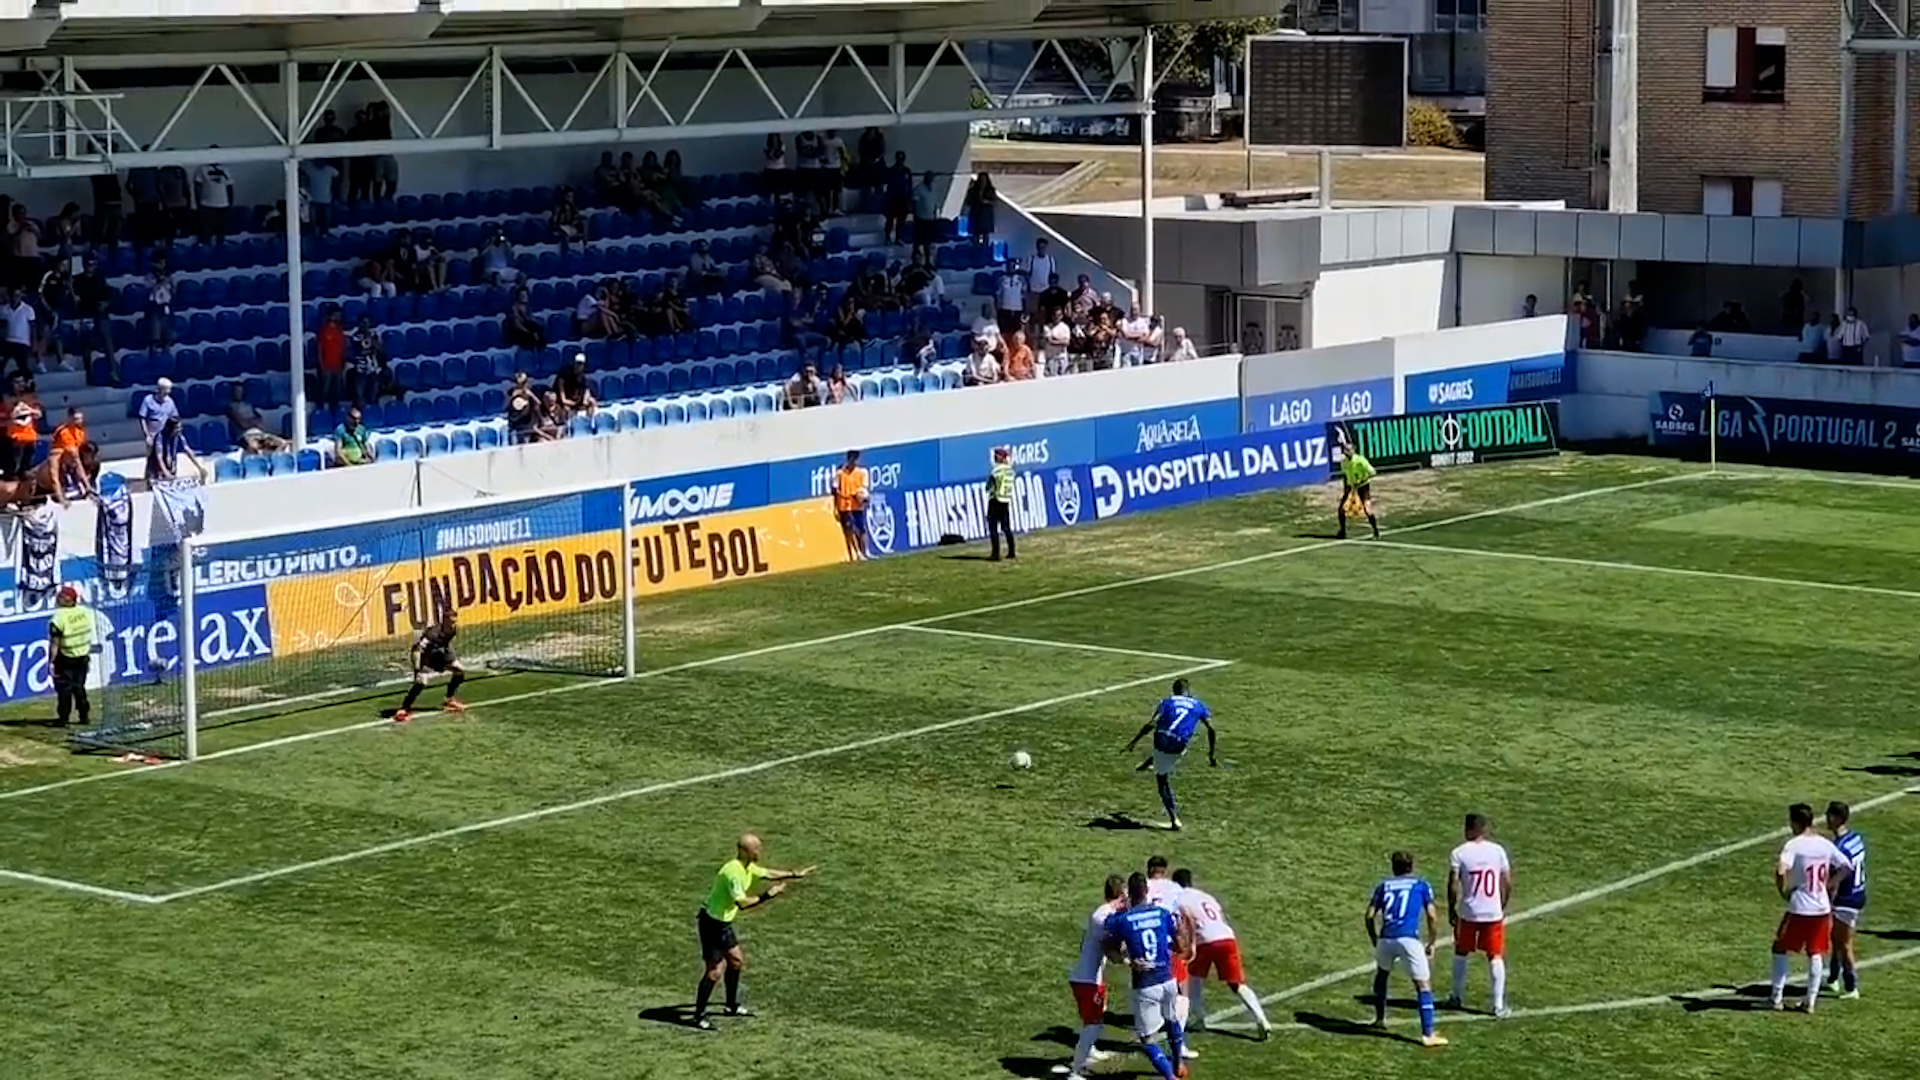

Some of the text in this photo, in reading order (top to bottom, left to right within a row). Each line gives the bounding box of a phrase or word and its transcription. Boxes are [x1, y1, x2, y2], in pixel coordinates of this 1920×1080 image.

[1269, 389, 1372, 427] LAGO LAGO
[1438, 378, 1474, 405] SAGRES
[1135, 414, 1201, 454] AQUARELA
[1353, 405, 1548, 460] THINKING FOOTBALL
[1699, 408, 1898, 449] LGA PORTUGAL 2
[1126, 449, 1240, 498] HOSPITAL
[1241, 444, 1279, 477] DA
[1282, 436, 1328, 471] LUZ
[383, 549, 567, 635] FUNDAÇÃO
[574, 548, 618, 604] DO
[118, 606, 272, 678] reax
[1168, 706, 1189, 731] 7
[1469, 869, 1496, 898] 70
[1202, 901, 1218, 922] 6
[1383, 889, 1410, 920] 21
[1141, 928, 1158, 961] 9
